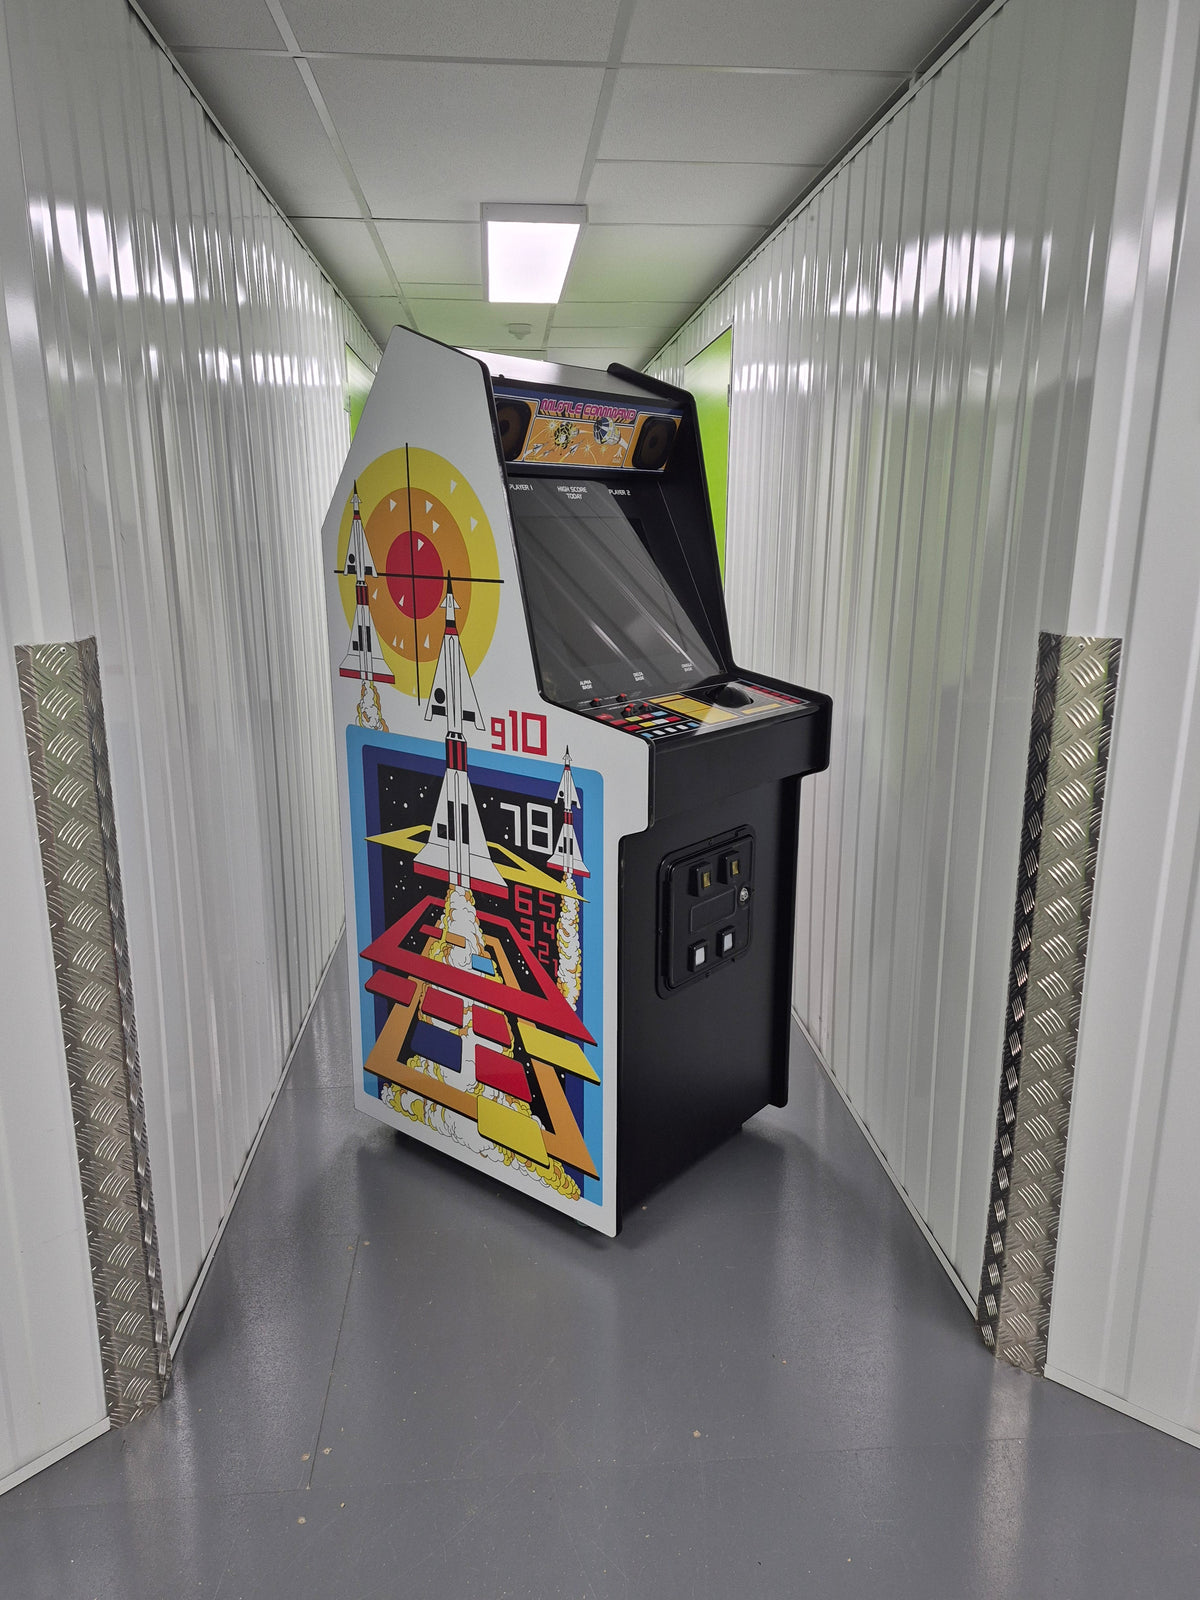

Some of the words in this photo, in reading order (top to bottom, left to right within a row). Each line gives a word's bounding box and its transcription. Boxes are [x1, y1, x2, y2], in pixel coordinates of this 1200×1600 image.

[540, 399, 583, 414] MISSILE
[583, 404, 637, 420] COMMAND
[509, 483, 529, 491] PLAYER
[570, 486, 588, 494] SCORE
